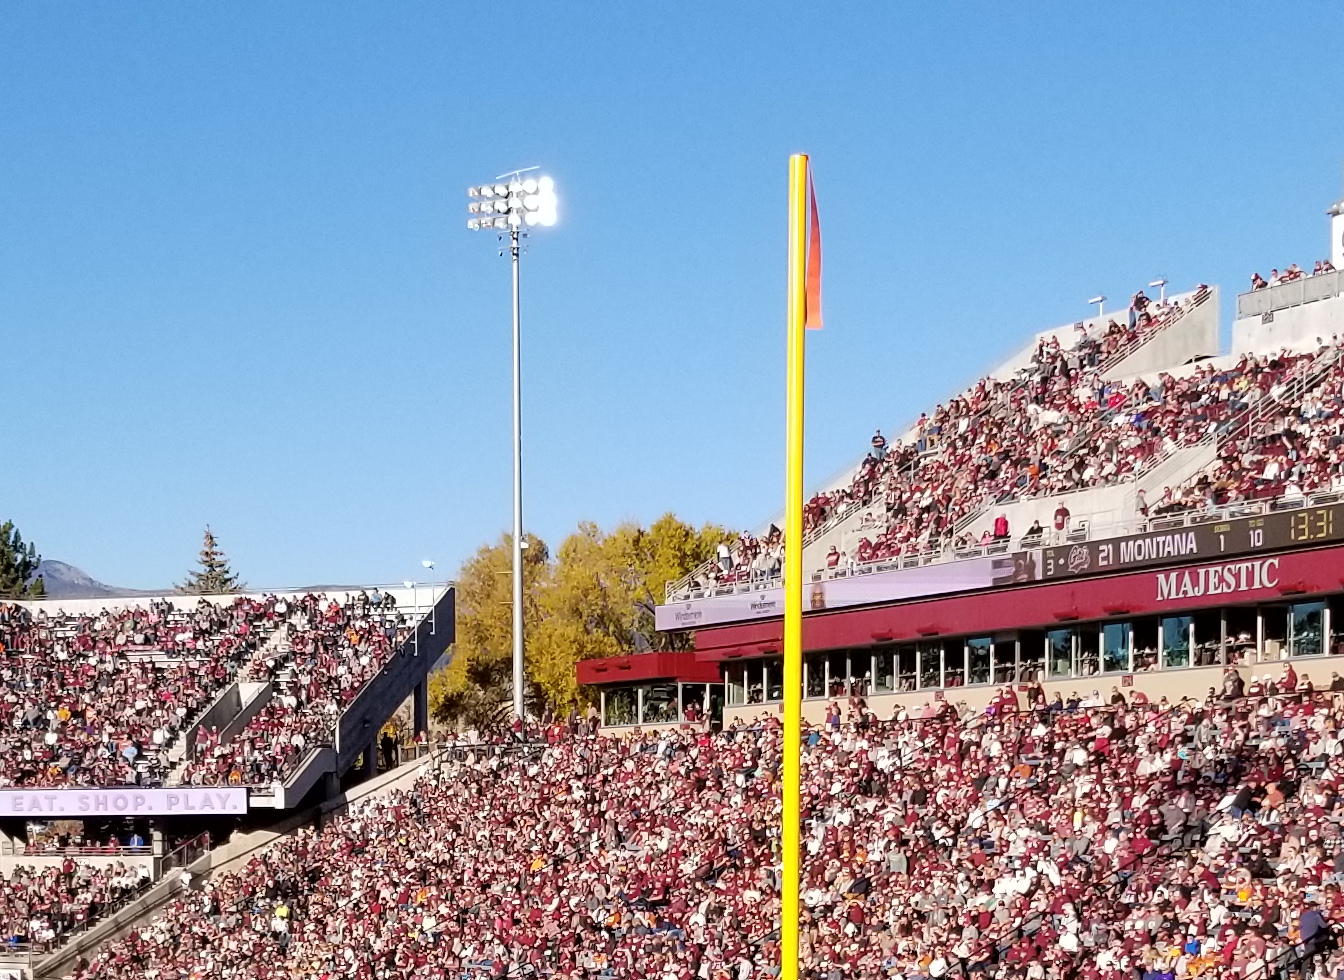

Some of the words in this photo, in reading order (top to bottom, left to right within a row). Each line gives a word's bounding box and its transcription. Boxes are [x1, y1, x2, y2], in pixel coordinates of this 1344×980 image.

[1291, 509, 1333, 541] 13:31
[1219, 534, 1225, 552] 1
[1249, 528, 1263, 548] 10
[1098, 545, 1114, 567] 21
[1120, 532, 1198, 563] MONTANA
[1046, 558, 1054, 576] 3
[1156, 558, 1280, 601] MAJESTIC
[11, 794, 64, 812] EAT.
[78, 794, 153, 812] SHOP.
[166, 793, 238, 811] PLAY.
